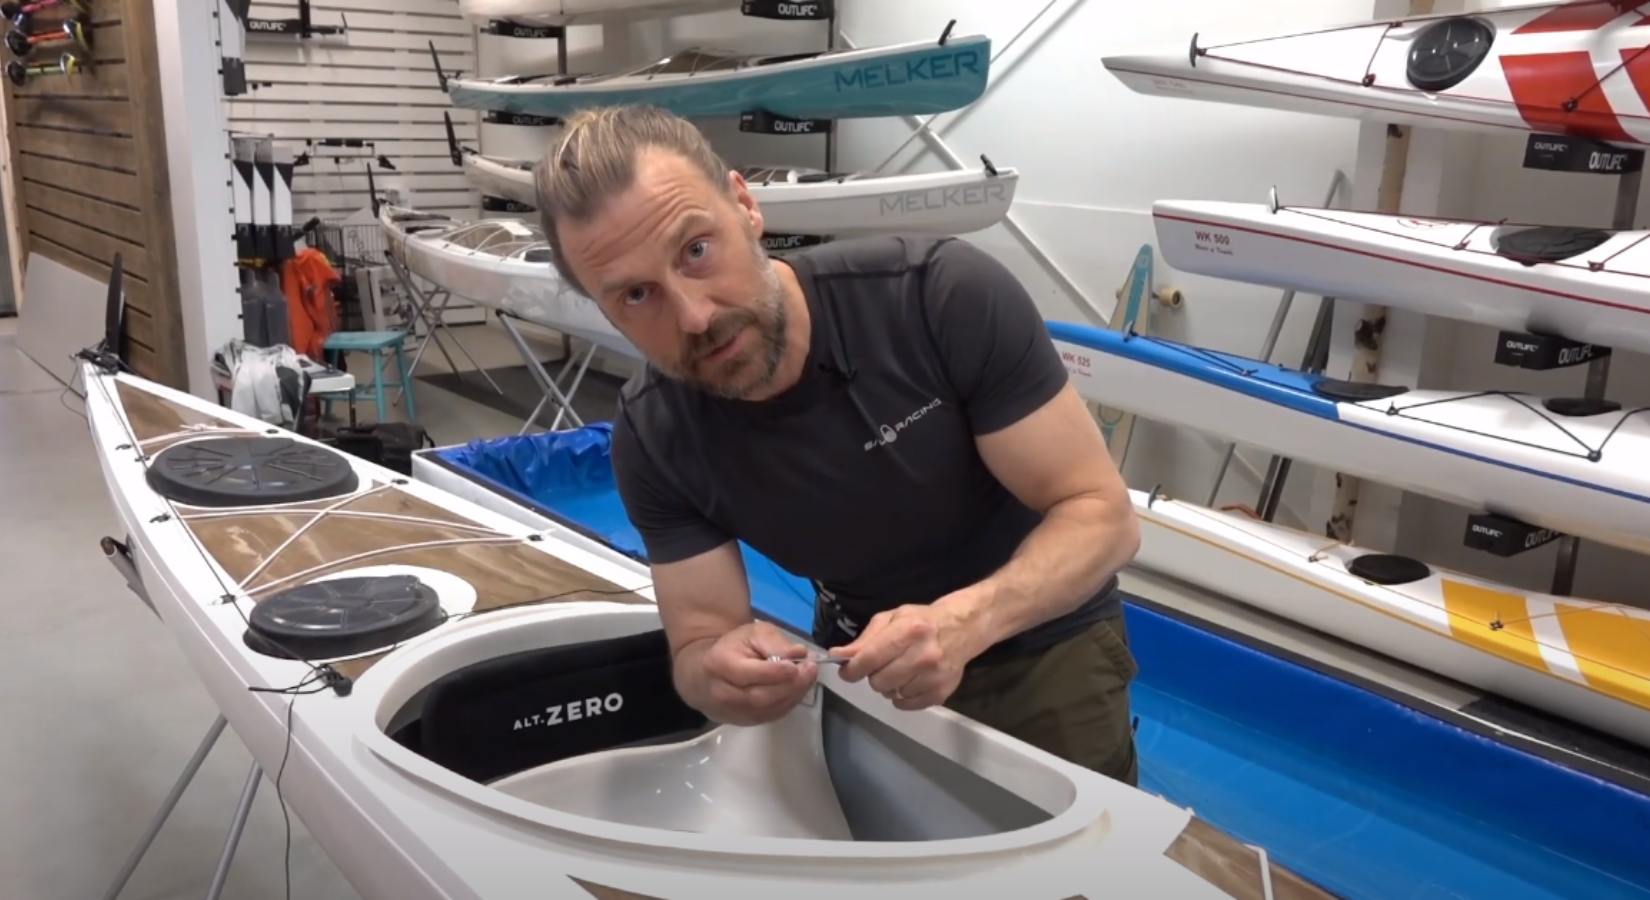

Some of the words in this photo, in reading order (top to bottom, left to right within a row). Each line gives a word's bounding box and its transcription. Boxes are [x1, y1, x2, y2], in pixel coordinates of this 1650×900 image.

[835, 50, 979, 92] MELKER
[879, 183, 1006, 216] MELKER
[895, 398, 942, 432] RACING
